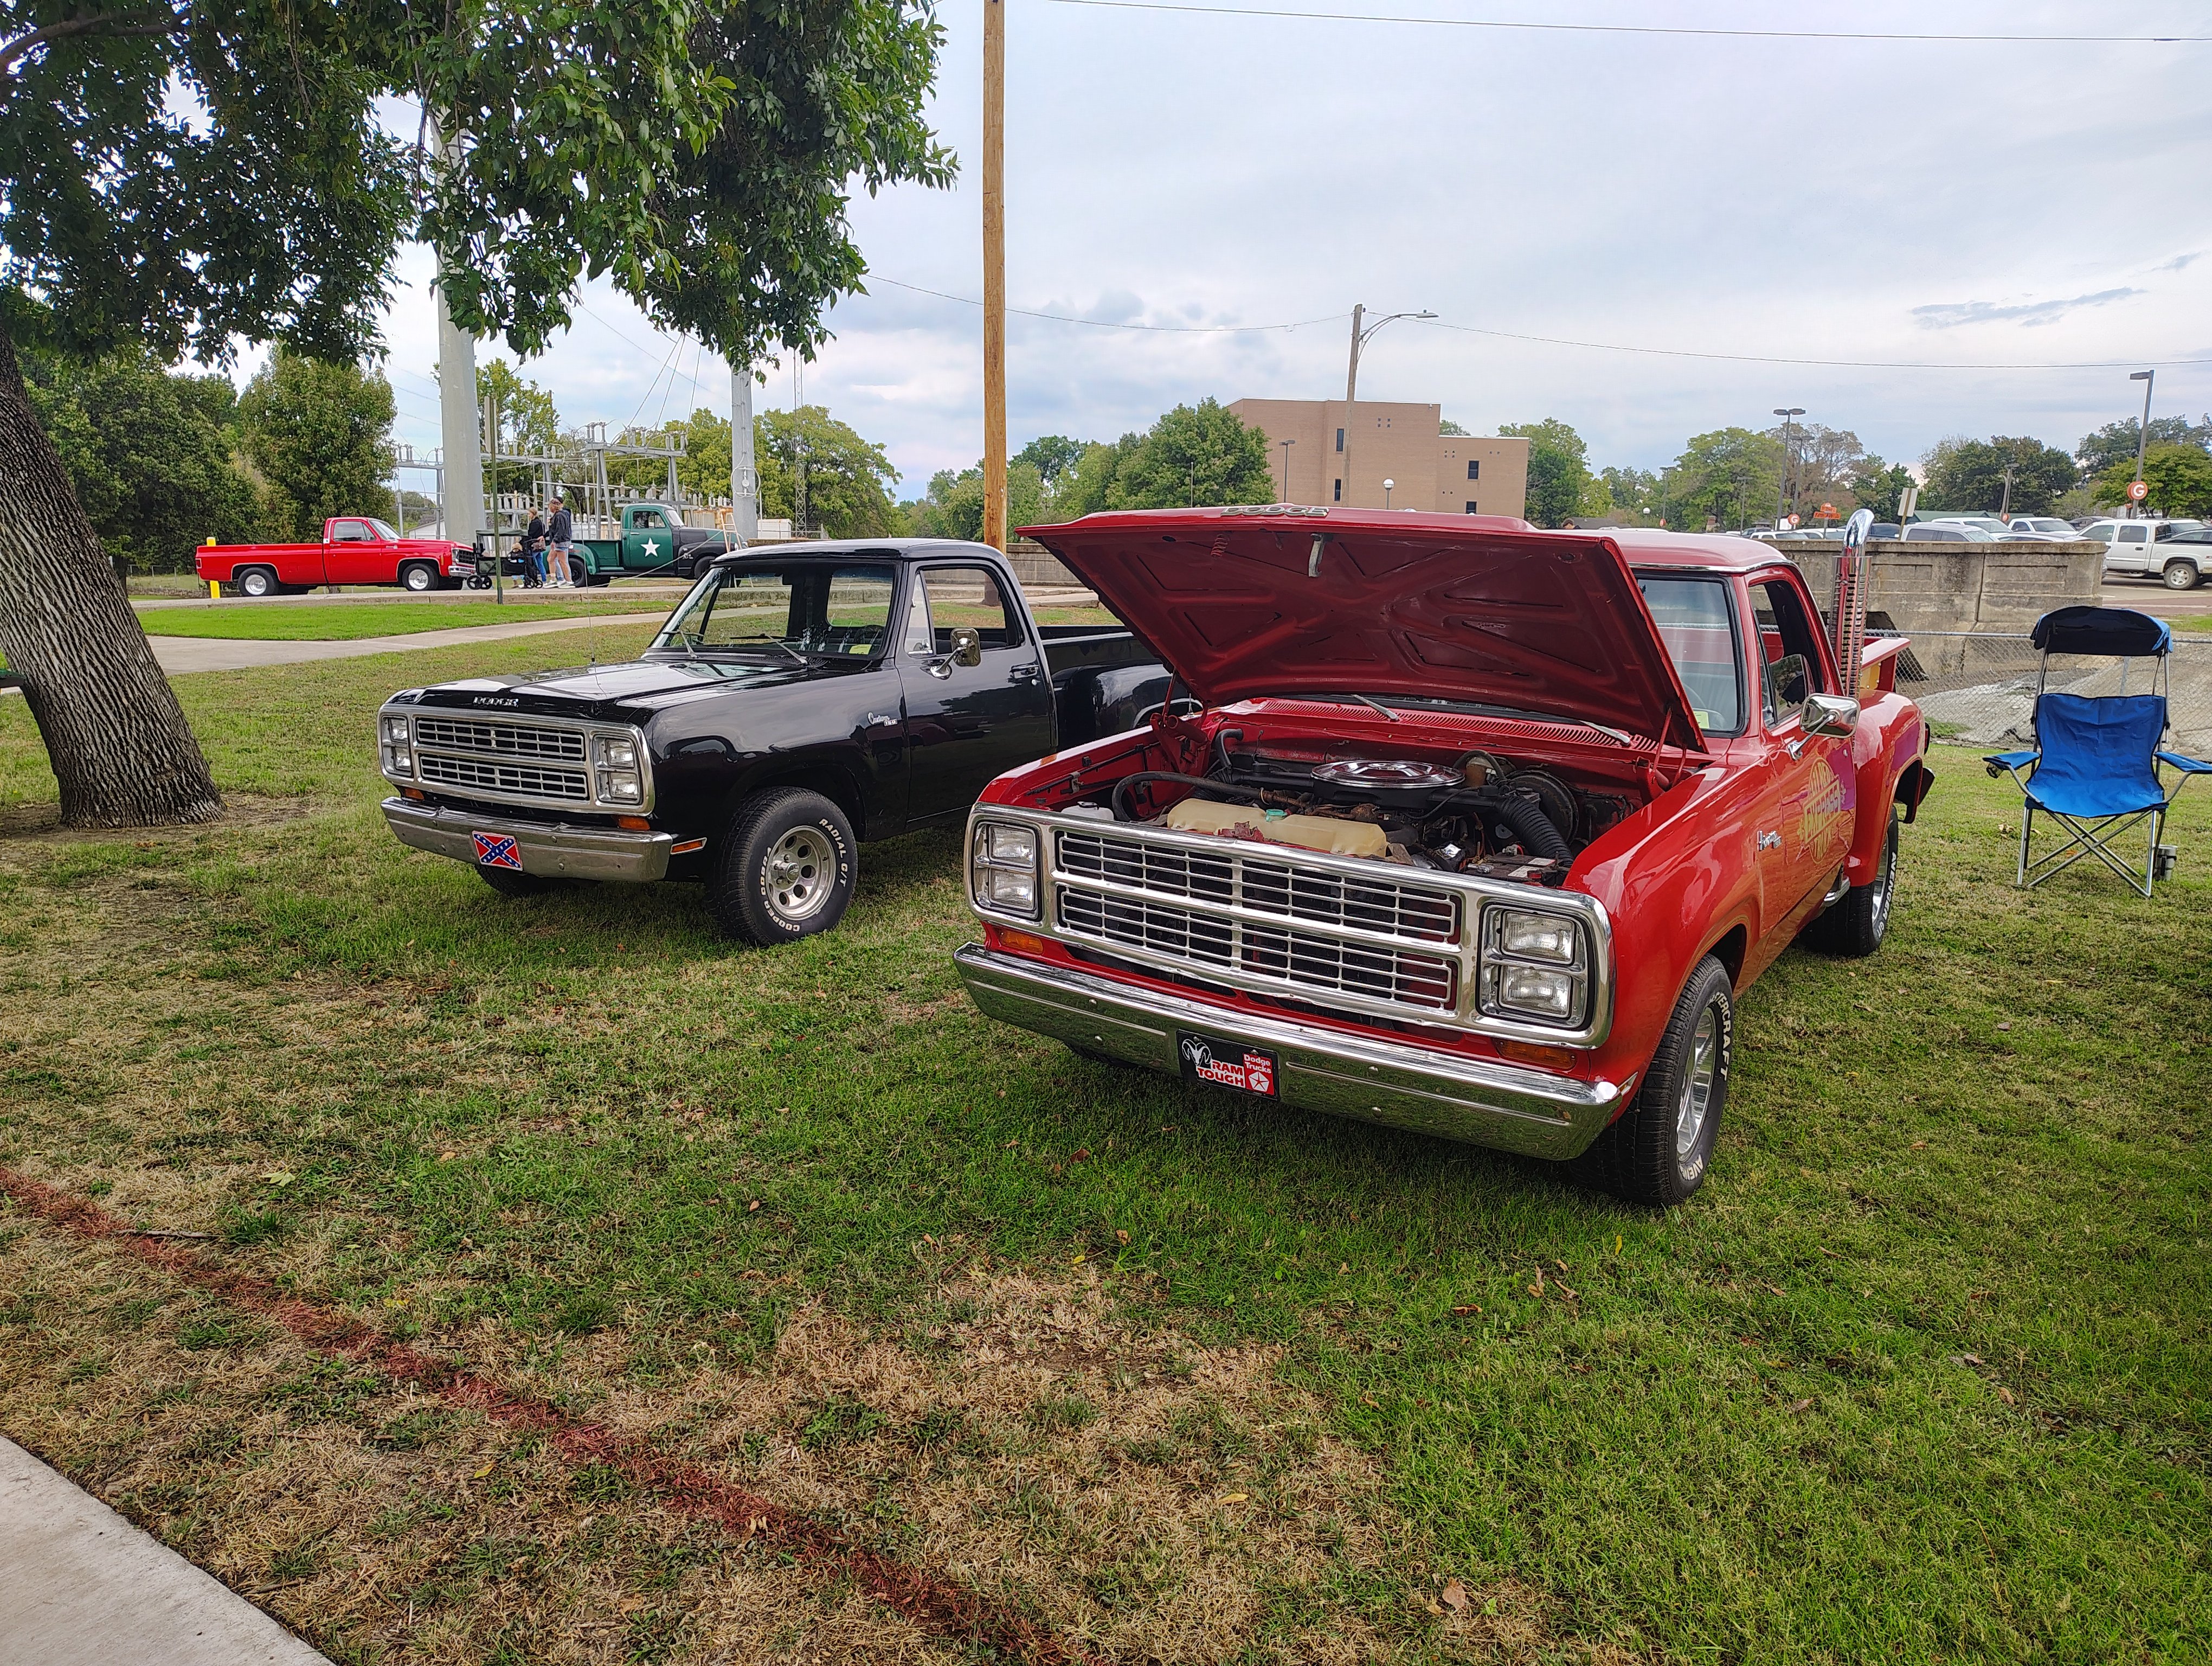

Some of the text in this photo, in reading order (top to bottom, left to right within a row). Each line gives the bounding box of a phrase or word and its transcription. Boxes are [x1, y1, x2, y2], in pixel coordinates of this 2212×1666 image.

[2133, 484, 2145, 497] G
[1220, 507, 1330, 517] DODGE
[818, 818, 848, 887] RADIAL G/T
[760, 847, 800, 932] COOPER COBRA
[1882, 851, 1896, 920] AVENGER
[1244, 1054, 1271, 1066] Dodge
[1245, 1061, 1272, 1074] Trucks
[1212, 1061, 1243, 1076] RAM
[1197, 1067, 1244, 1087] TOUGH
